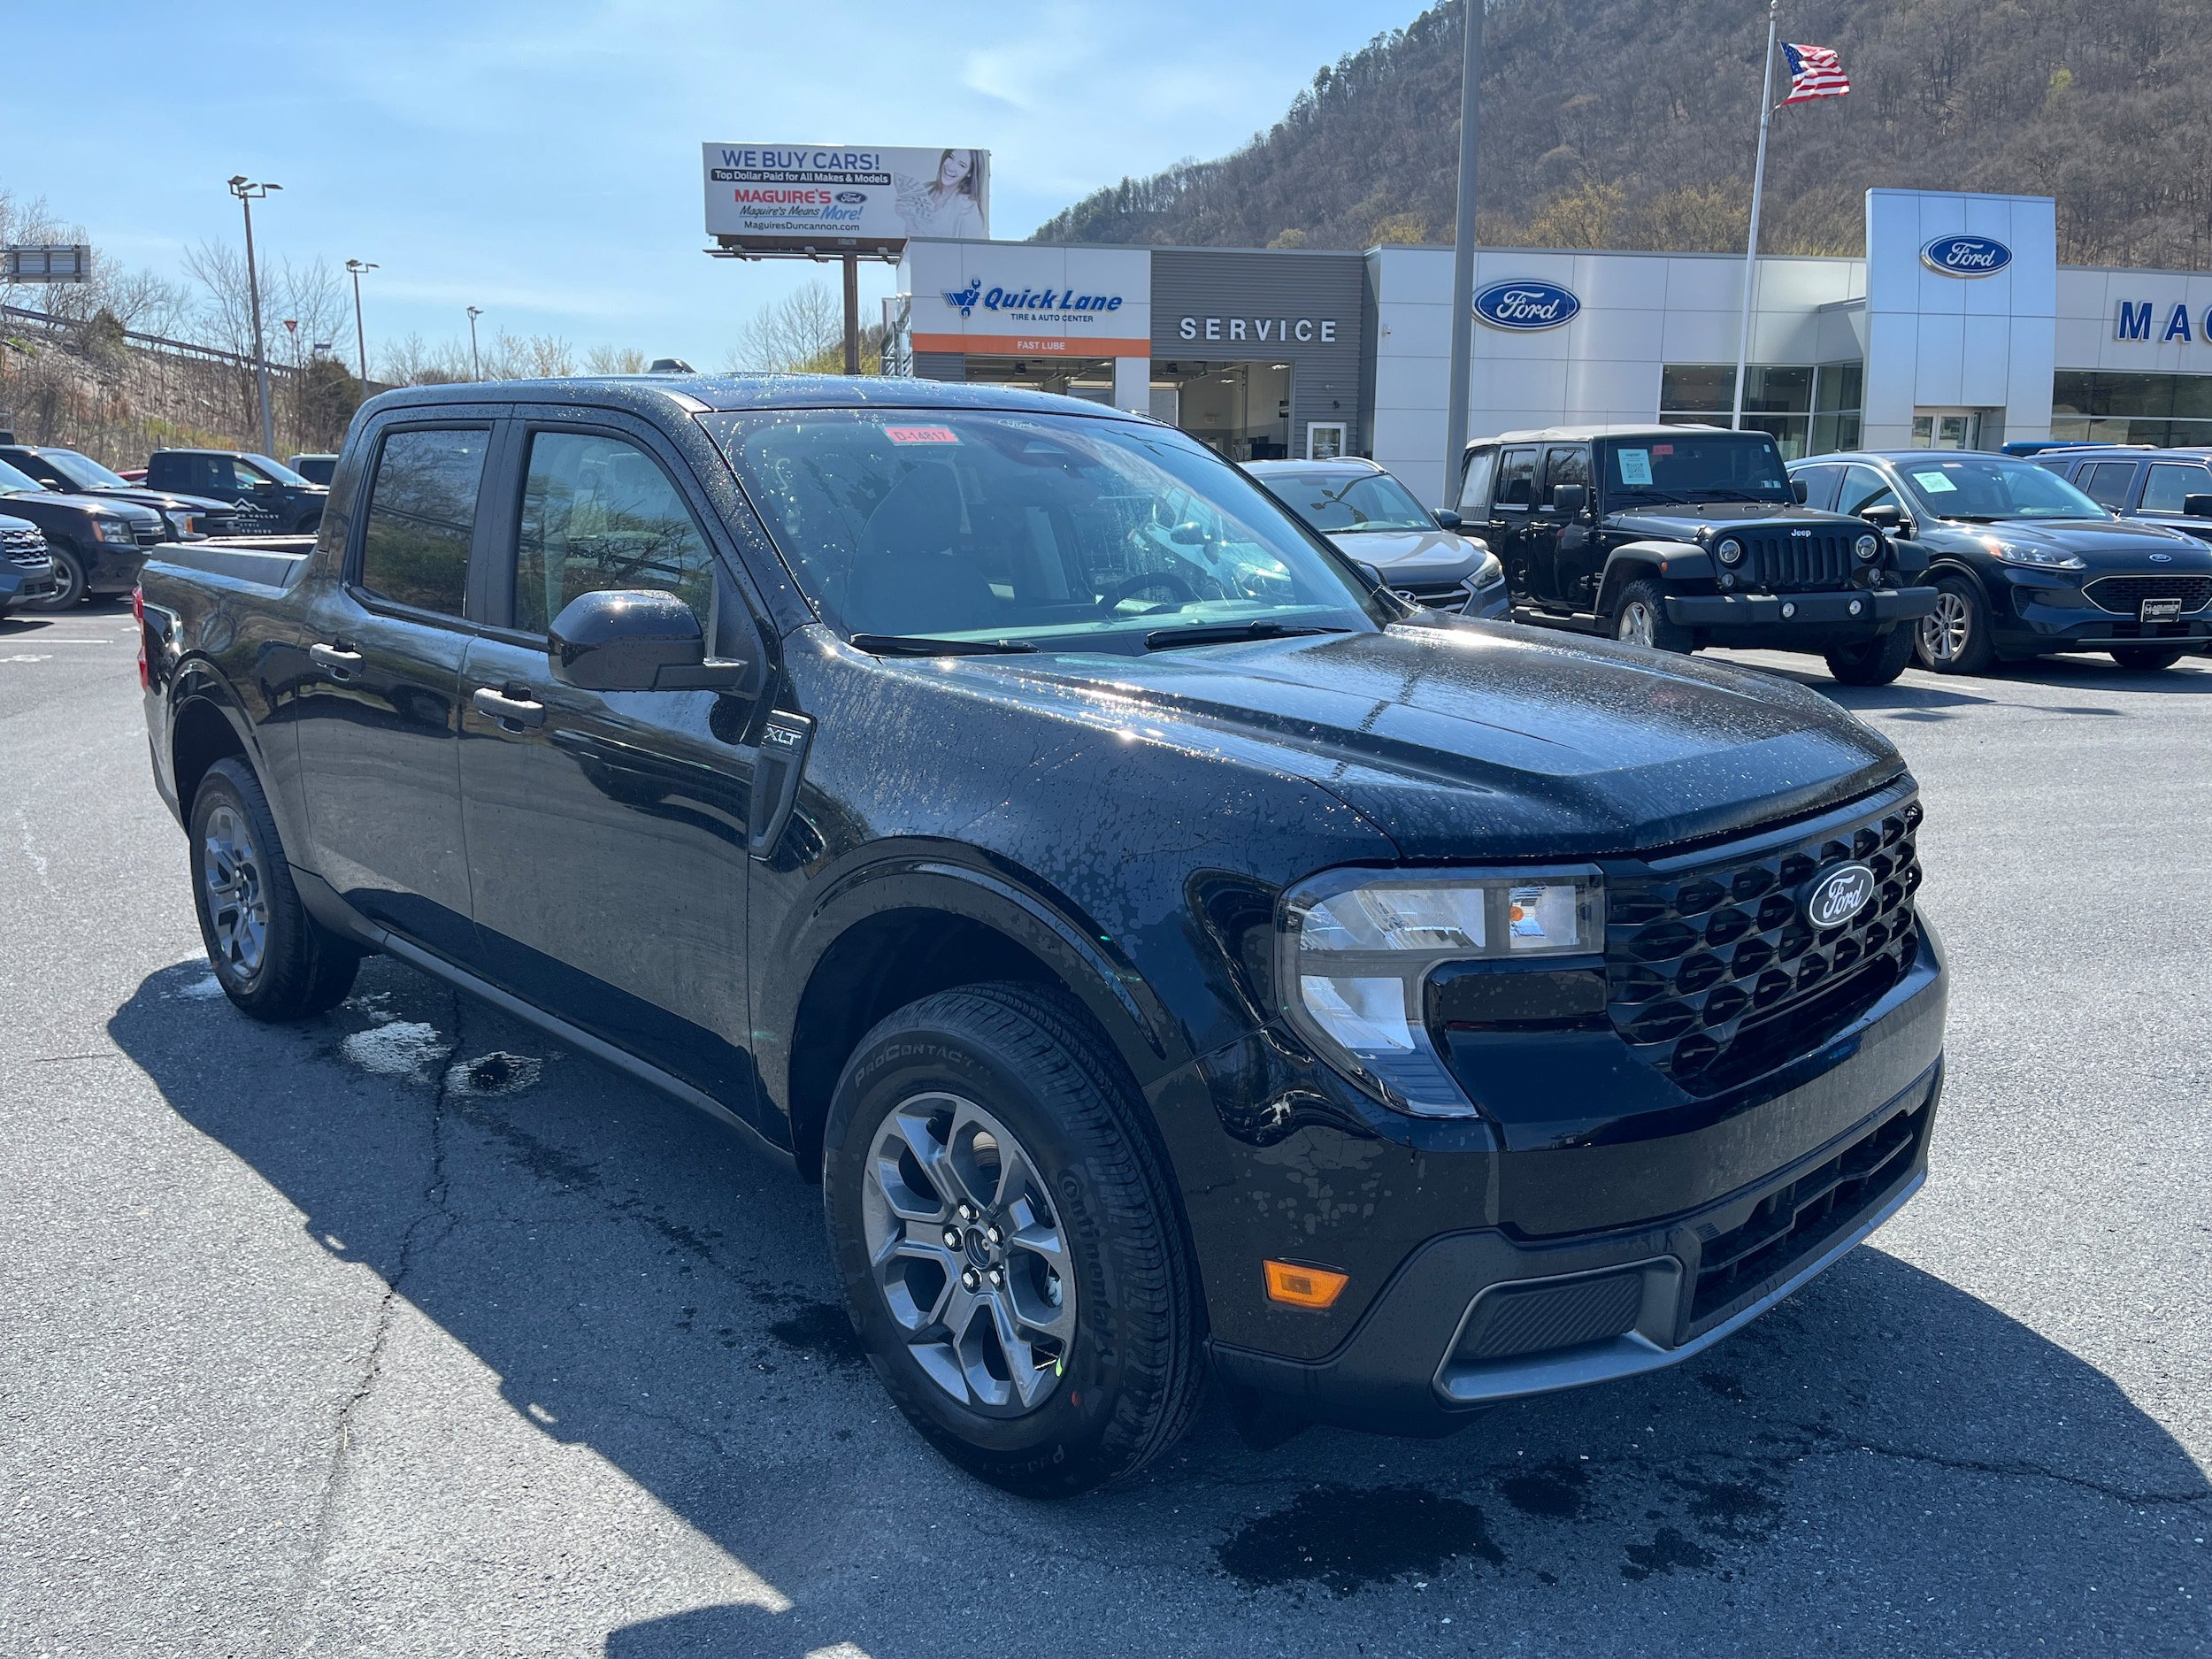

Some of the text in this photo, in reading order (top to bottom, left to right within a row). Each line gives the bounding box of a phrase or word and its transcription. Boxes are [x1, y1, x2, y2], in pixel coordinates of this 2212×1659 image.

[721, 150, 879, 171] WE BUY CARS!
[715, 170, 888, 184] Top Dollar Paid for All Makes & Models
[734, 188, 832, 204] MAGUIRE'S
[739, 205, 864, 220] Maguire's Means More!
[744, 221, 860, 231] MaguiresDuncannon.com
[1947, 242, 1996, 266] Ford
[985, 287, 1123, 311] Quick Lane
[1496, 290, 1560, 319] Ford
[1062, 314, 1094, 323] CENTER
[2118, 301, 2212, 342] MA
[1179, 317, 1336, 342] SERVICE
[1018, 341, 1065, 350] FAST LUBE
[895, 431, 948, 441] D-14817
[764, 726, 802, 746] XLT
[1823, 874, 1864, 919] Ford
